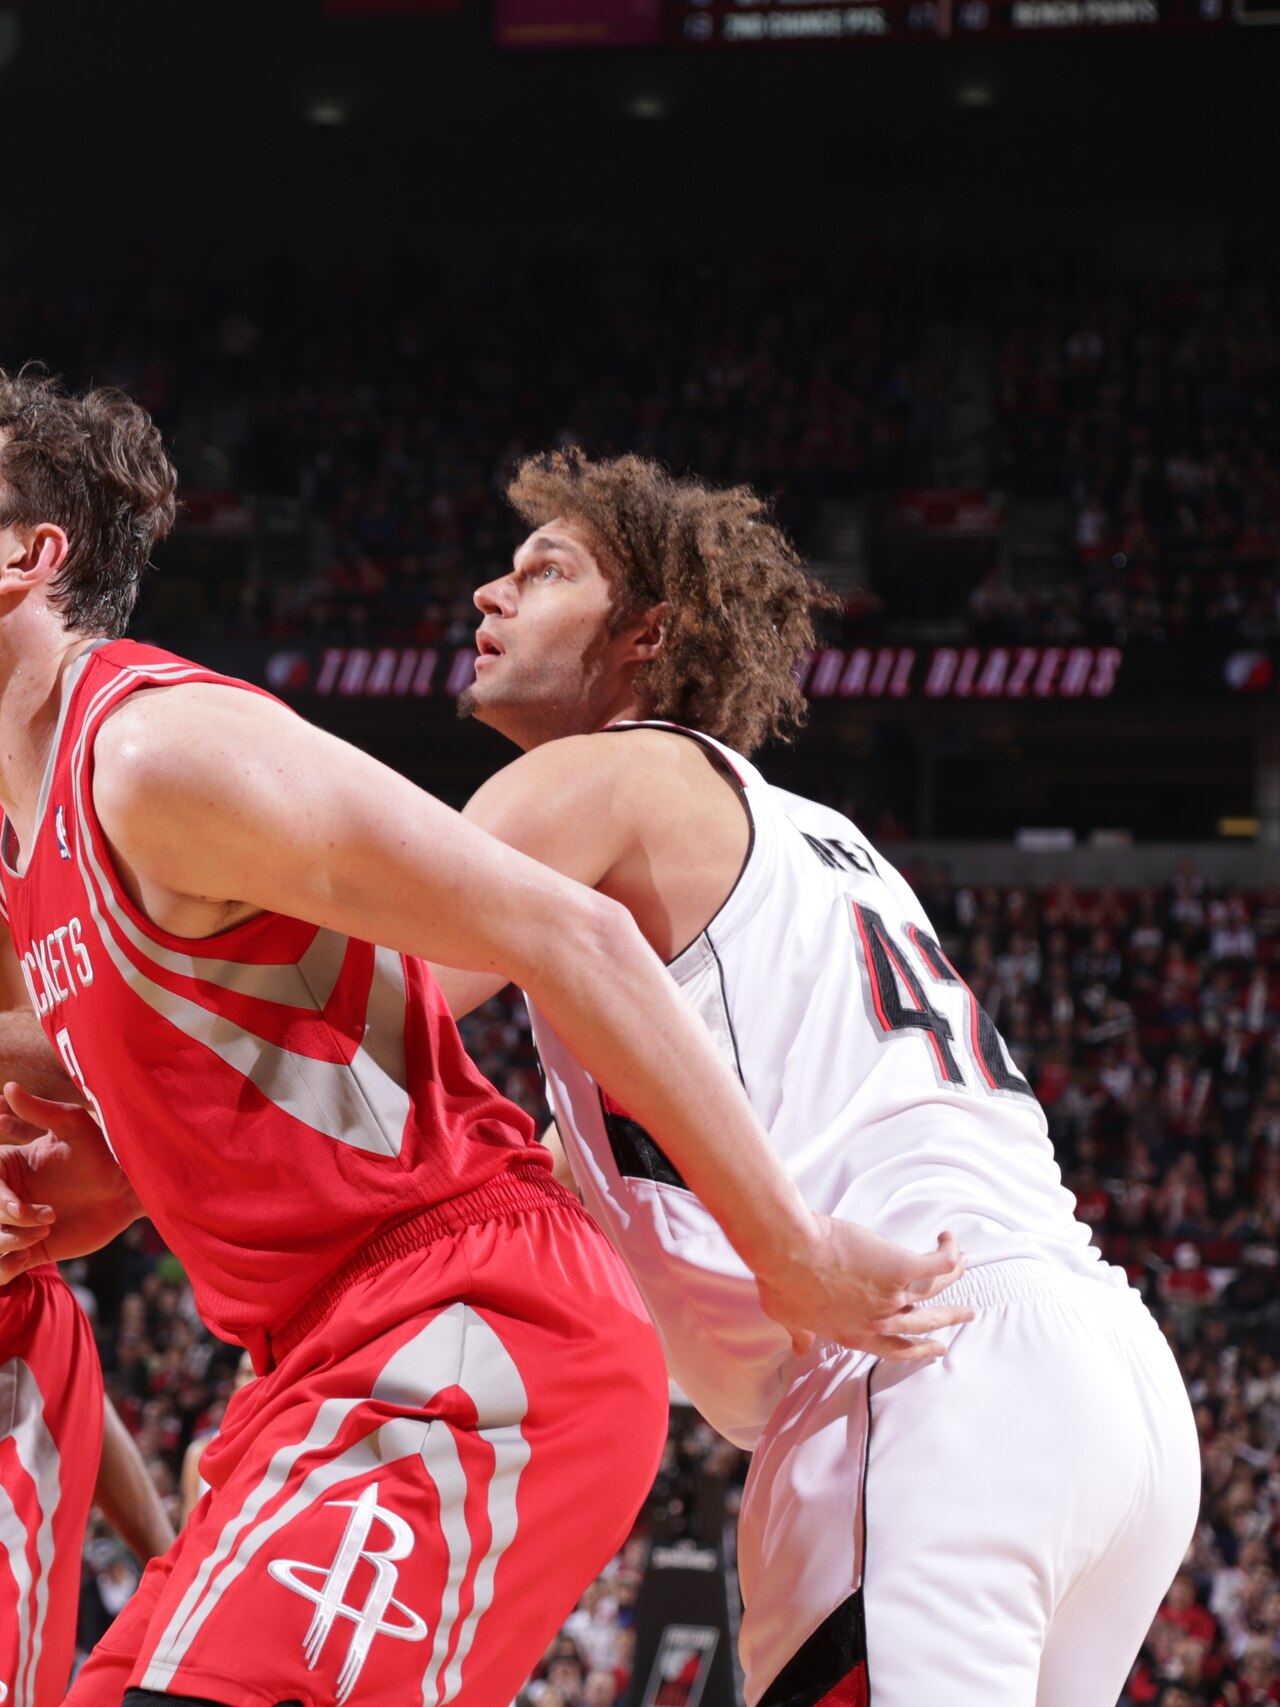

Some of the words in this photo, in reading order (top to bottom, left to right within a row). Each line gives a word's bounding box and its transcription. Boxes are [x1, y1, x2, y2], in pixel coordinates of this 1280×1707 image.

[316, 648, 438, 697] TRAIL
[794, 648, 916, 697] RAIL
[924, 647, 1121, 698] BLAZERS
[842, 892, 1038, 1106] 42
